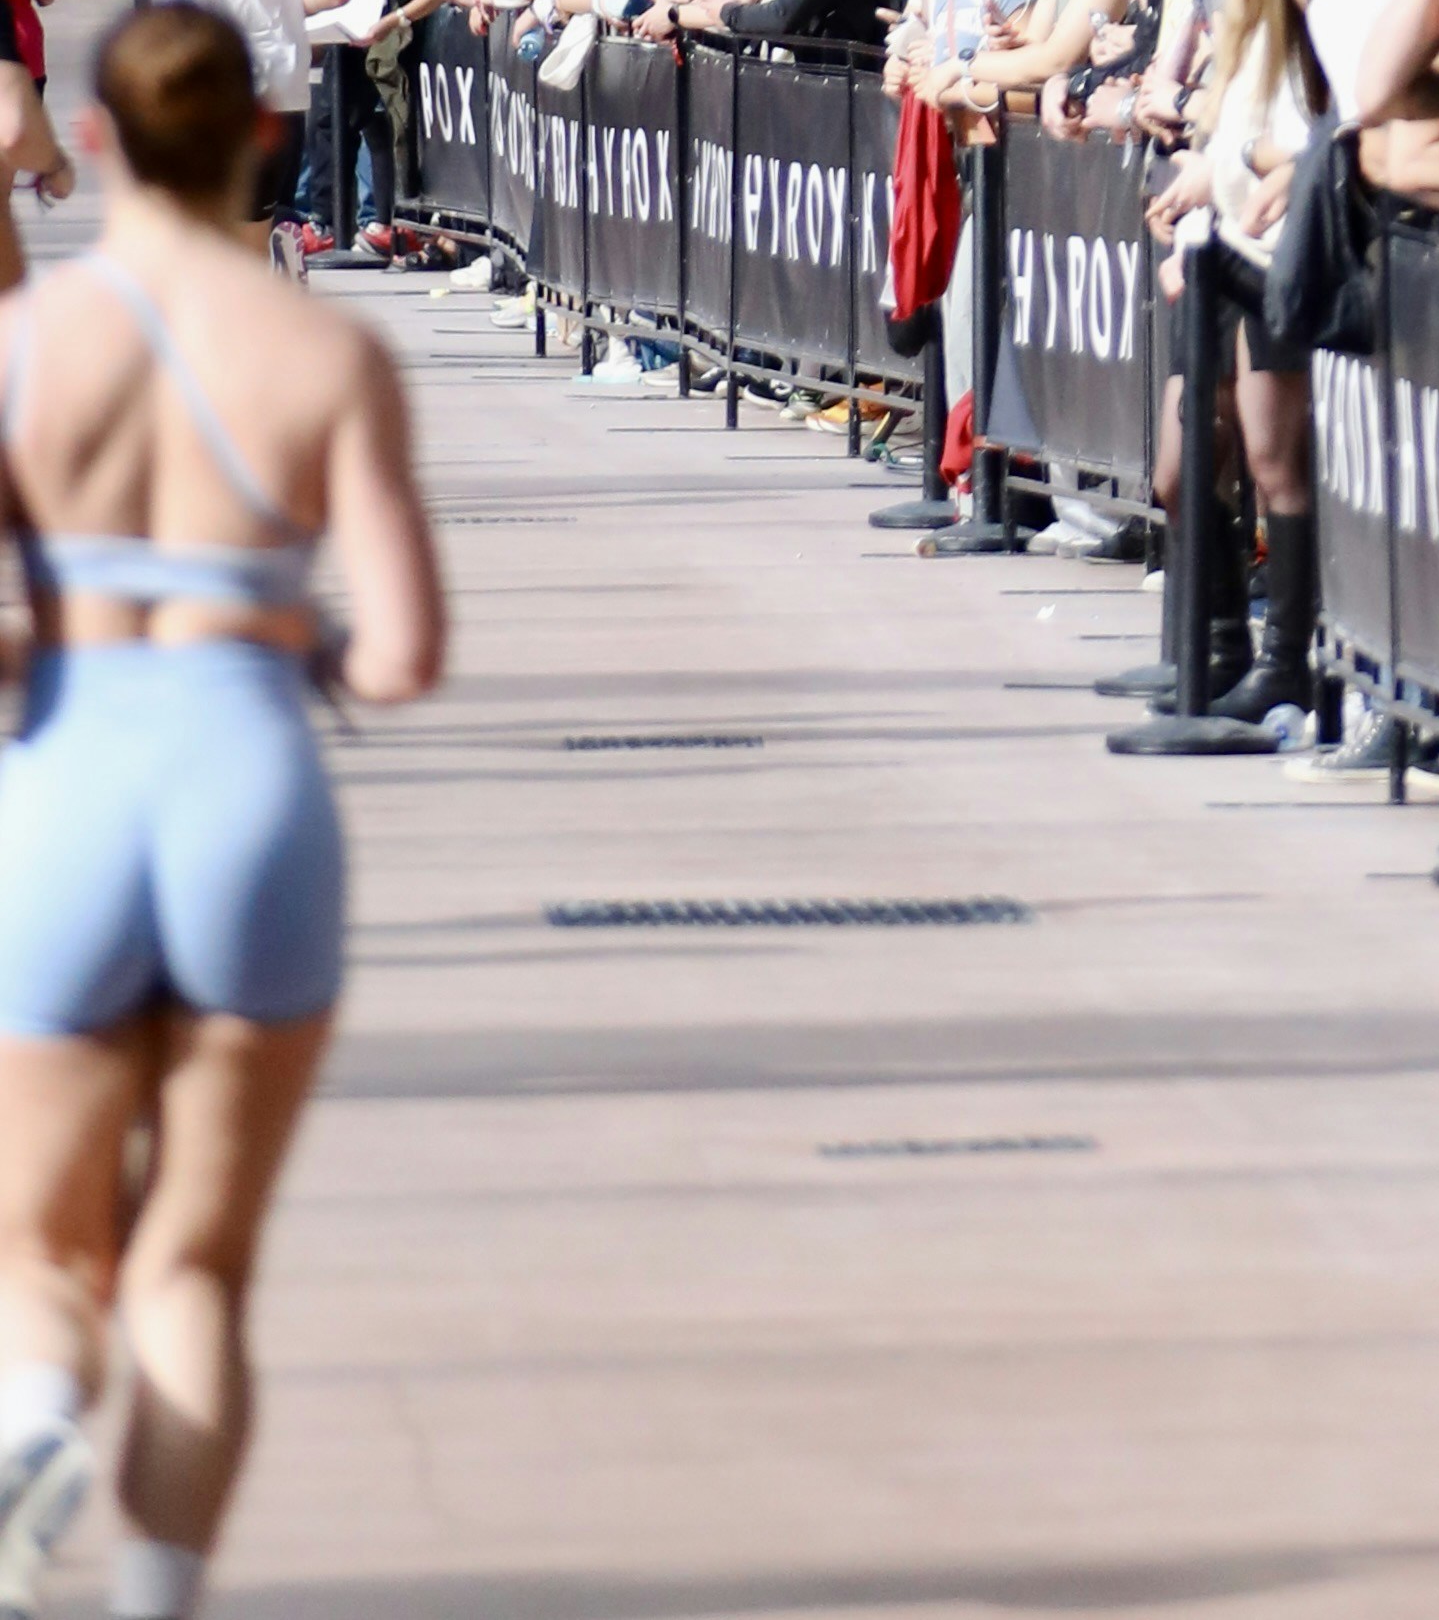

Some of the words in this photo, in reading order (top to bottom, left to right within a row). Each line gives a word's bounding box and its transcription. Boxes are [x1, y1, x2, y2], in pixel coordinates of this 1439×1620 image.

[419, 61, 477, 145] ROX
[587, 124, 674, 222] HYROX
[743, 153, 846, 267] HYROX
[1010, 226, 1140, 361] HYROX
